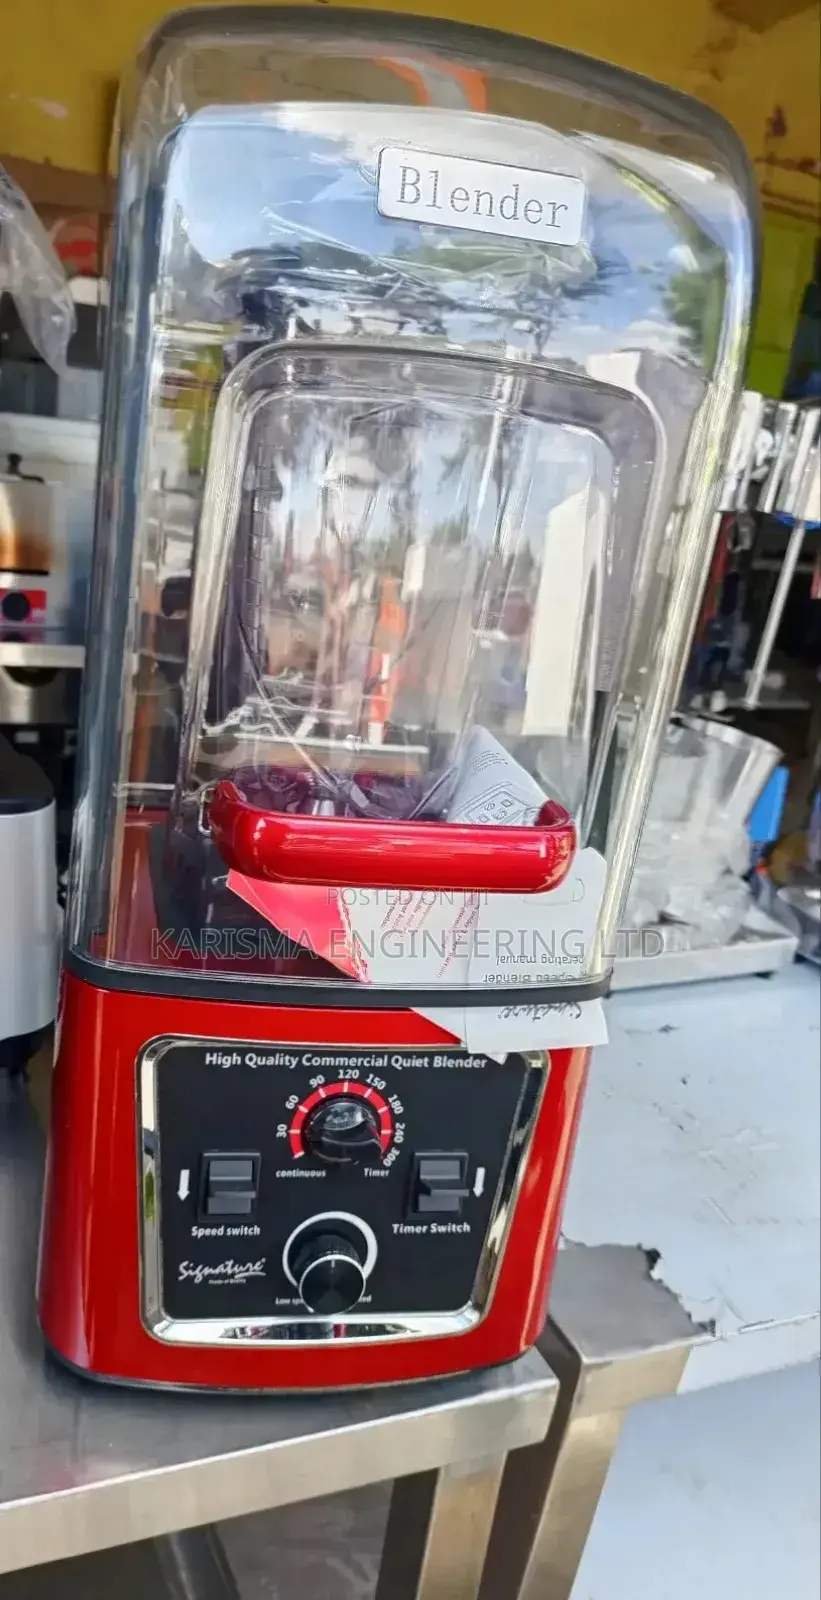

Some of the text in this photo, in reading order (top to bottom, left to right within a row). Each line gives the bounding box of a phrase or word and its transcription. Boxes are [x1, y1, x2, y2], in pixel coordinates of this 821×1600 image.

[397, 165, 568, 228] Blender
[497, 954, 584, 965] perating manual
[205, 1053, 488, 1069] High Quality Commercial Quiet Blender
[309, 1074, 326, 1089] 90
[337, 1069, 360, 1079] 120
[365, 1073, 387, 1091] 150
[285, 1094, 300, 1111] 60
[388, 1094, 404, 1115] 180
[276, 1123, 288, 1139] 30
[394, 1122, 406, 1144] 240
[382, 1148, 400, 1168] 300
[276, 1168, 326, 1178] continuous
[363, 1168, 390, 1177] Timer
[191, 1225, 261, 1238] Speed switch
[392, 1222, 471, 1234] Timer Switch
[178, 1257, 266, 1284] Signature
[275, 1297, 291, 1305] Low
